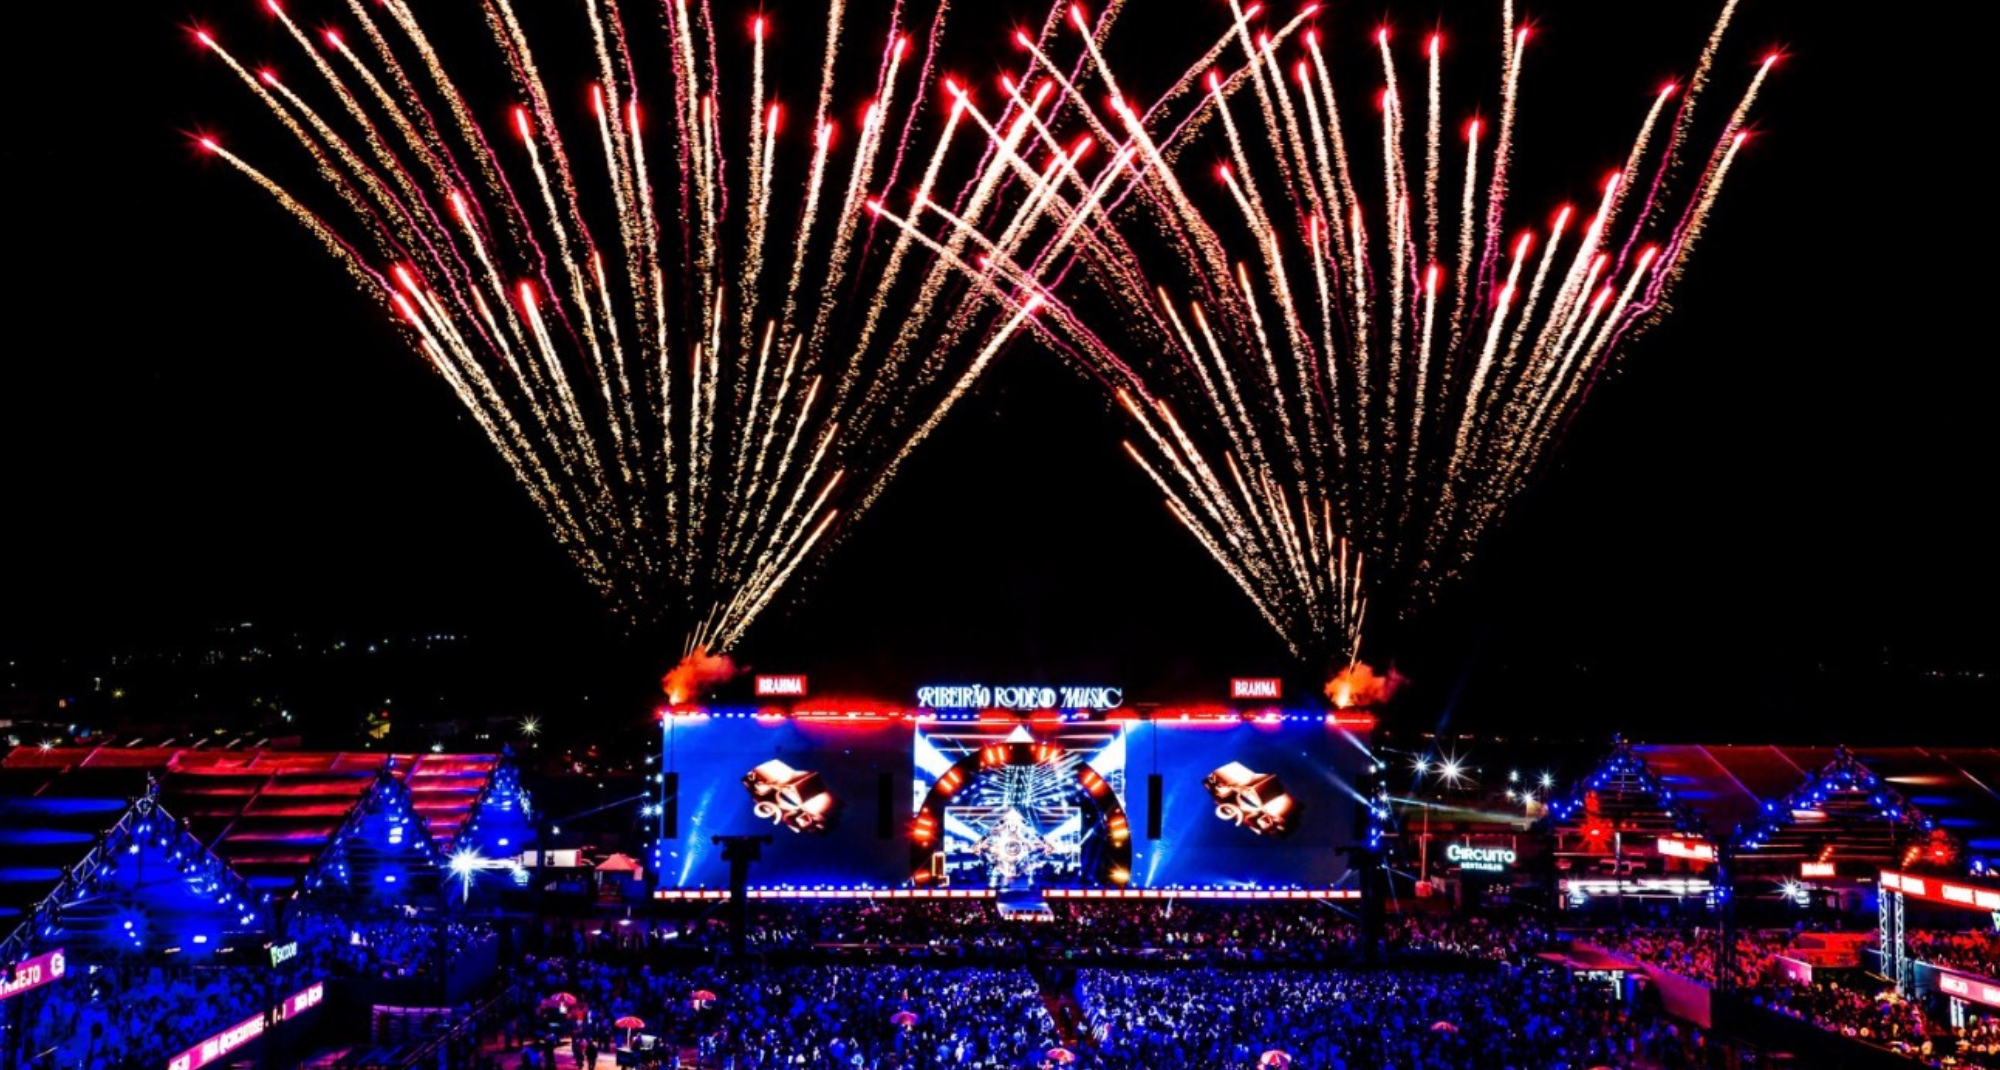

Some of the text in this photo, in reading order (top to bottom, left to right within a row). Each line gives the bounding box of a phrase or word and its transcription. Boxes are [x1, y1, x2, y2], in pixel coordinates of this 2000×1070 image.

[758, 677, 802, 694] BRAHMA
[1235, 680, 1277, 697] BRAHMA
[917, 684, 1123, 710] RIBEIRÃO RODEO MUSIC
[1447, 844, 1516, 864] CIRCUITO
